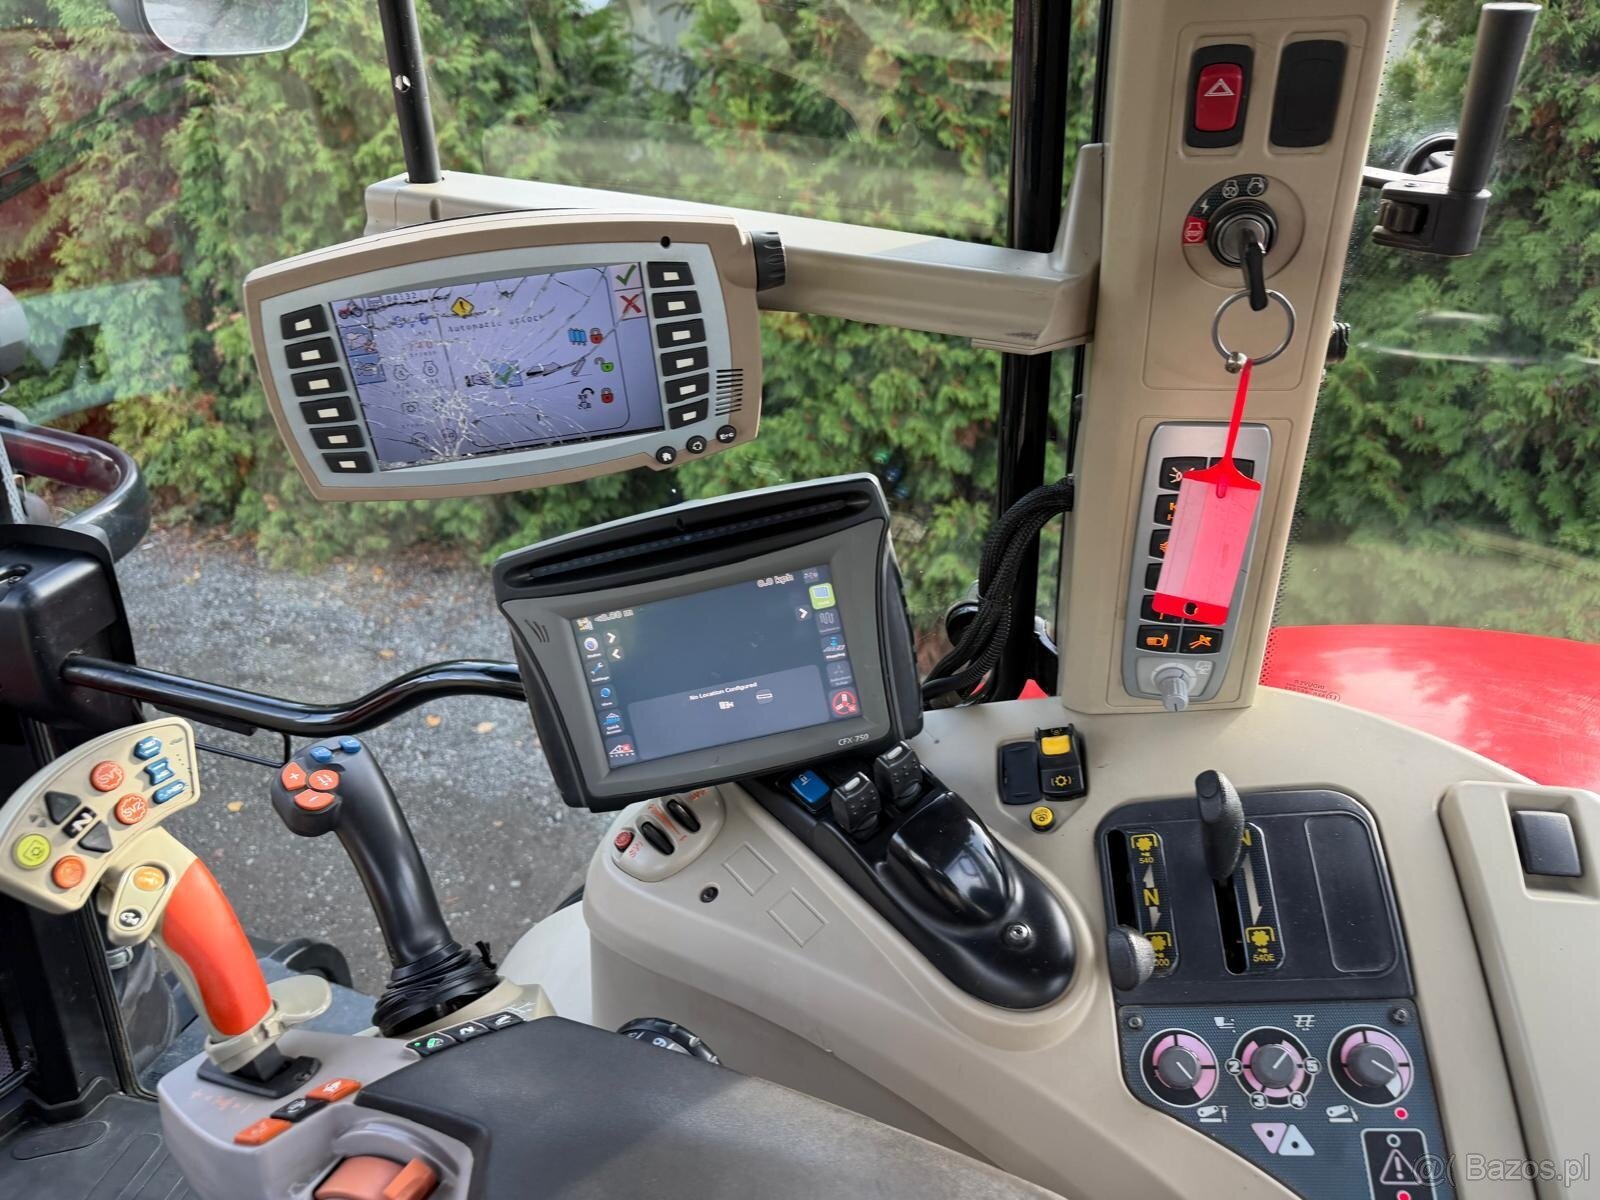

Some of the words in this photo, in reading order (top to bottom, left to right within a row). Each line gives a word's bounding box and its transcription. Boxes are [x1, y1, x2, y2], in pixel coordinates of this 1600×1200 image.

[699, 688, 725, 699] Location
[725, 681, 758, 693] Configured
[122, 800, 144, 816] SV2
[1143, 888, 1160, 906] N
[1253, 953, 1276, 963] 540E
[1228, 1061, 1240, 1073] 2
[1305, 1060, 1318, 1073] 5
[1252, 1094, 1265, 1107] 3
[1291, 1094, 1305, 1107] 4
